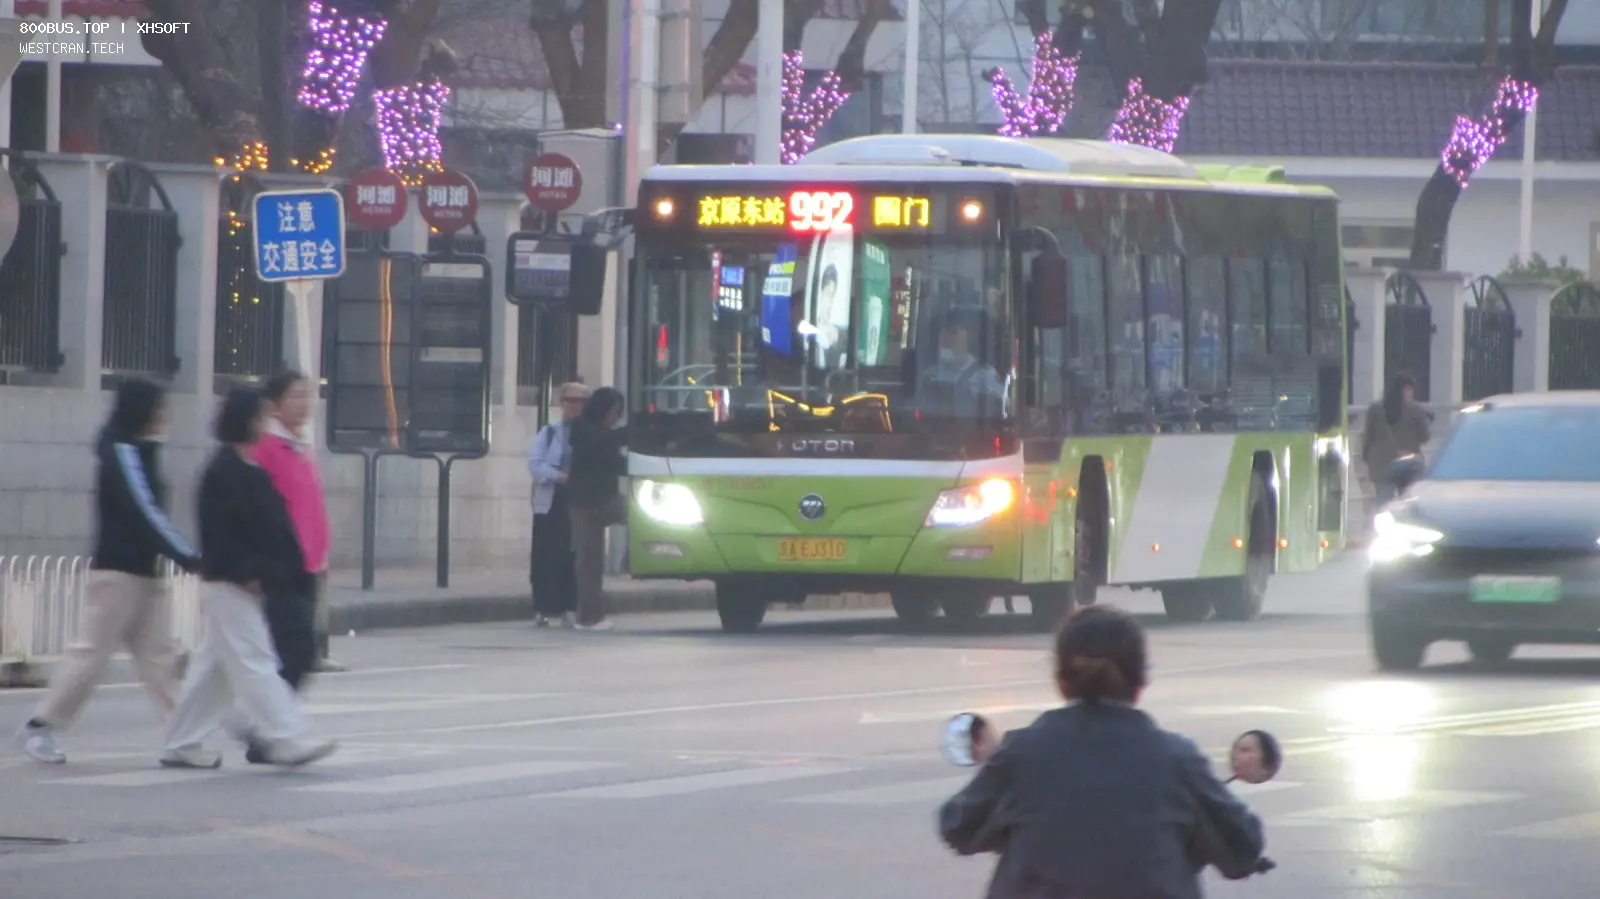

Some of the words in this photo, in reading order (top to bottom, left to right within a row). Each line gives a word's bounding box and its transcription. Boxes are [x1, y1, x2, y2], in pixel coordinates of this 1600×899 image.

[276, 200, 316, 233] 注意
[790, 191, 854, 231] 992
[262, 238, 337, 273] 交通安全
